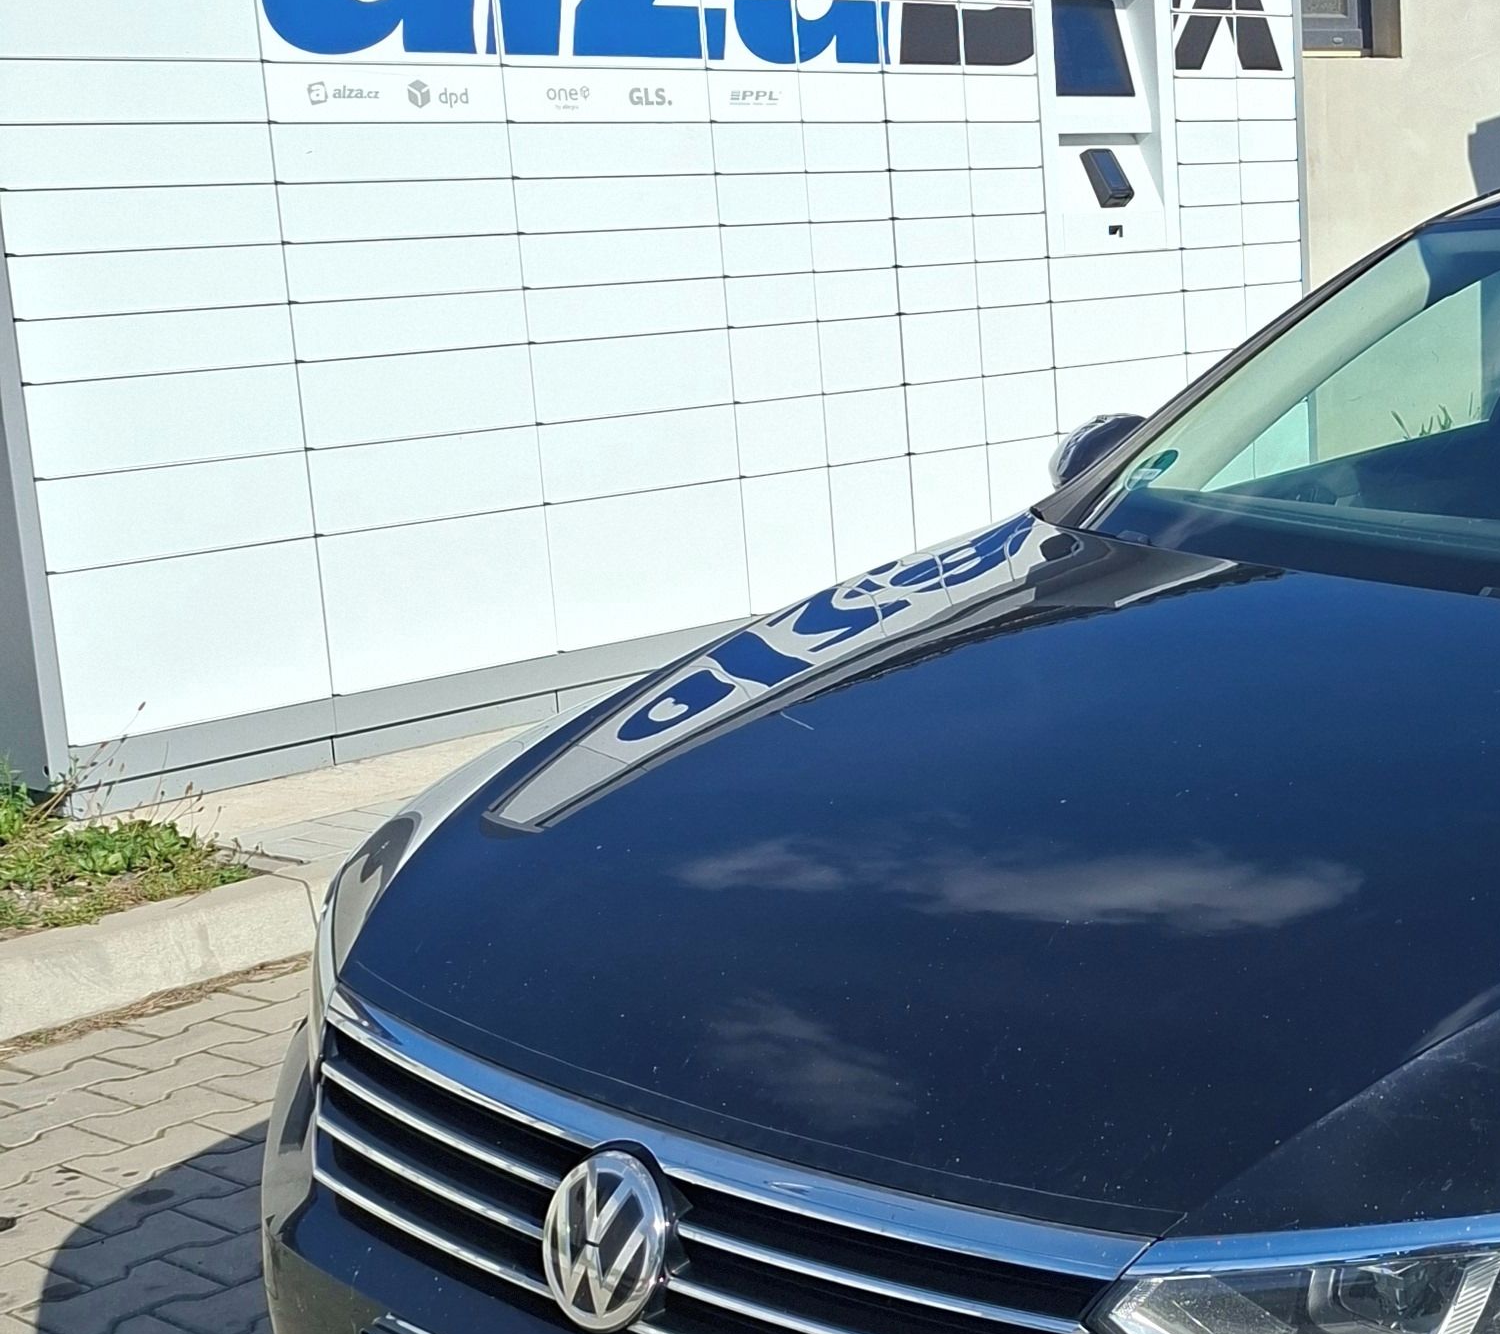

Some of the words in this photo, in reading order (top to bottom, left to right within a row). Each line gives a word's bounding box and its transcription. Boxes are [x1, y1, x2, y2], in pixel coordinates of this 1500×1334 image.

[332, 85, 380, 99] alza.cz
[438, 87, 470, 108] dpd
[546, 87, 579, 101] one
[629, 87, 673, 106] GLS.
[741, 90, 779, 101] PPL
